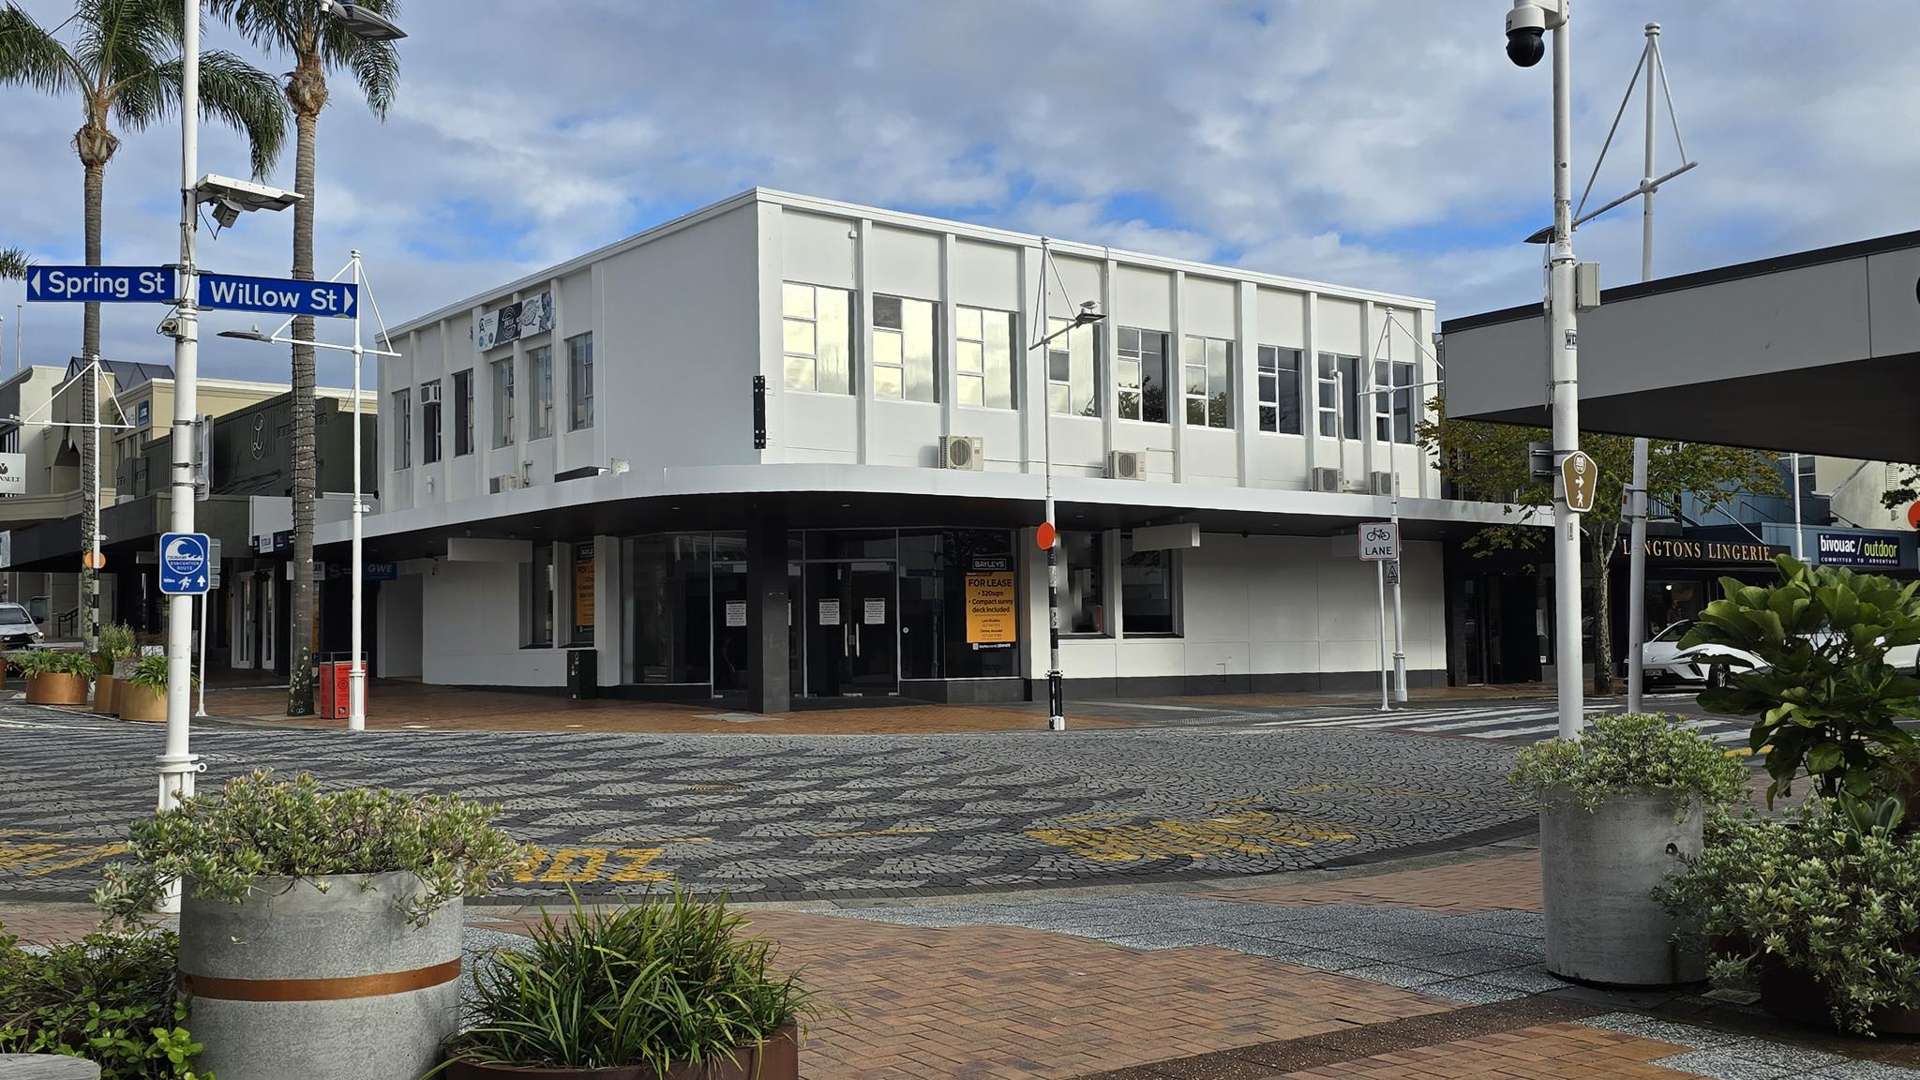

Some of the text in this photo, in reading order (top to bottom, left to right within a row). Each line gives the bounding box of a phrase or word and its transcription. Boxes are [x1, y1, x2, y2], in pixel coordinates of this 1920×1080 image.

[48, 271, 165, 299] Spring St
[209, 280, 338, 311] Willow St
[1365, 546, 1392, 556] LANE
[1622, 539, 1771, 561] LNGTONS LINGERIE
[1820, 534, 1856, 553] bivouac
[1864, 540, 1898, 558] outdoor
[968, 578, 1013, 587] FOR LEASE
